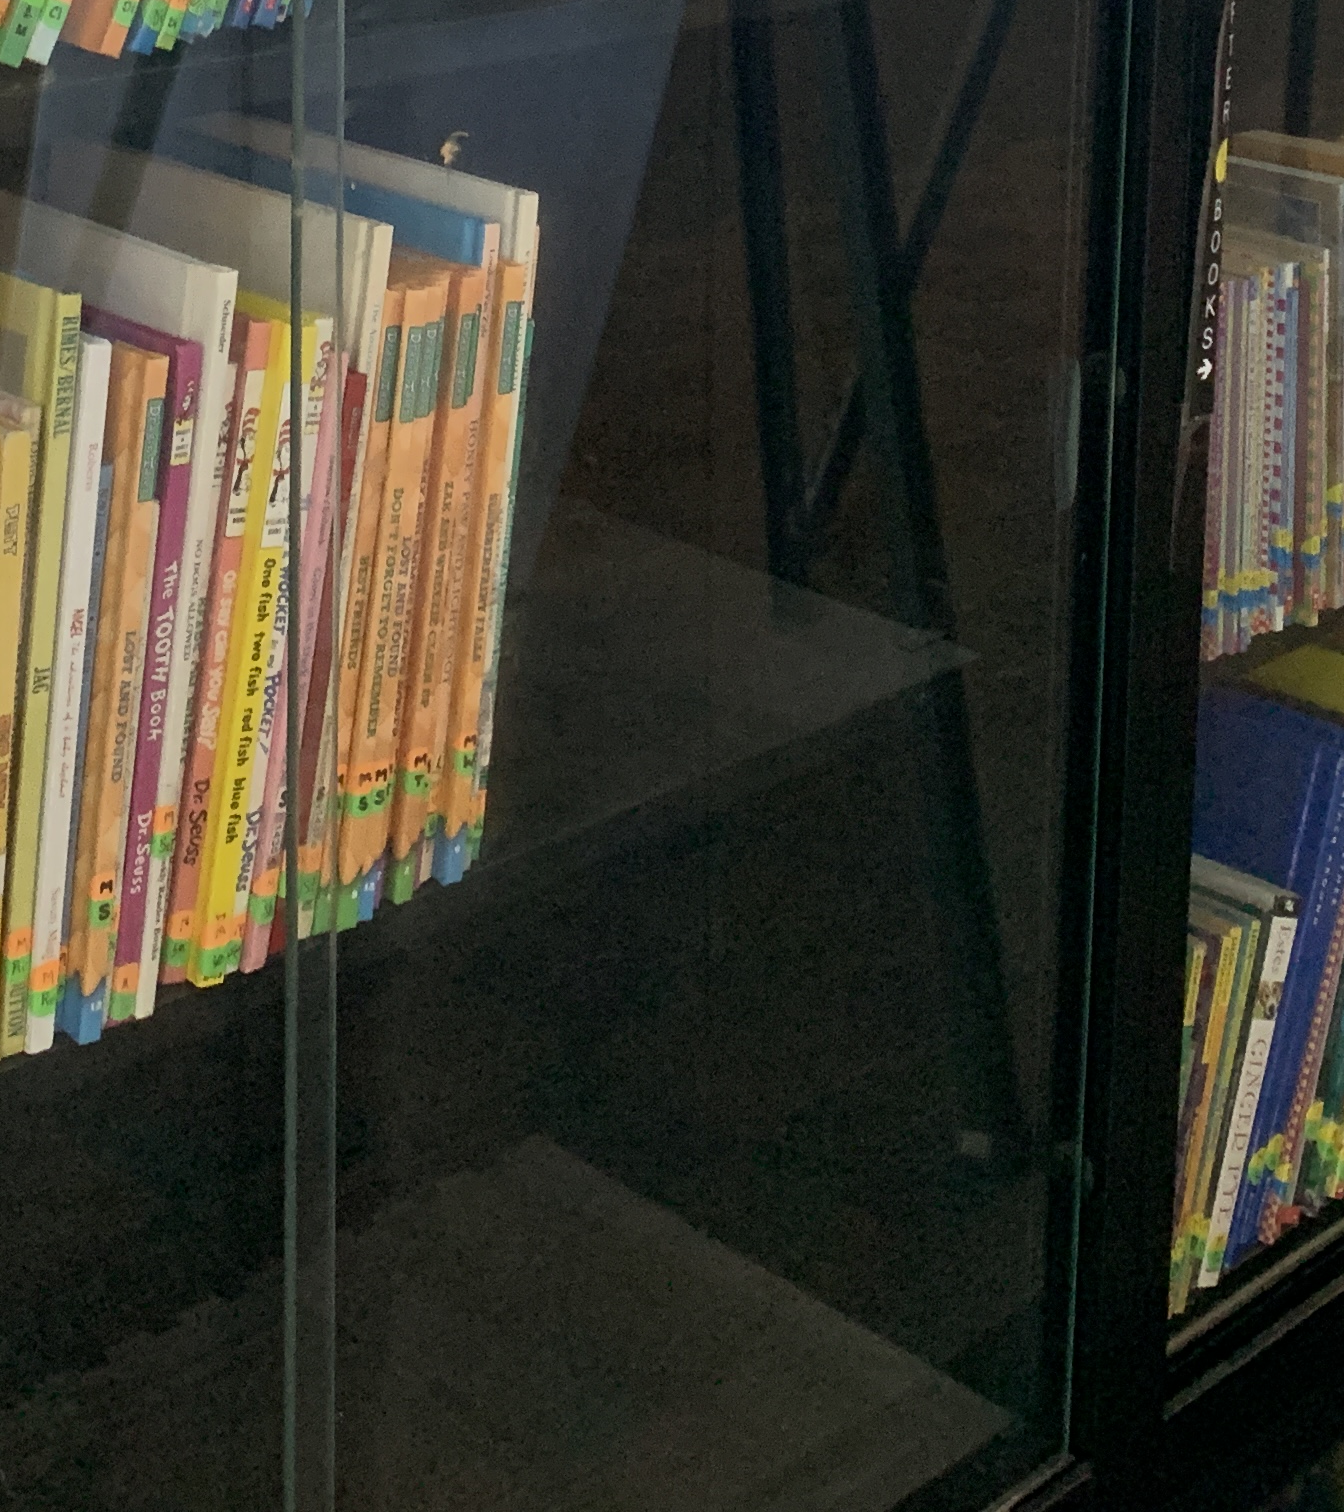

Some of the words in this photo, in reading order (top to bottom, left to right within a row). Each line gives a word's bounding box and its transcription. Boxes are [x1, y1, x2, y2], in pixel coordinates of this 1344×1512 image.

[1200, 197, 1222, 350] BOOKS
[161, 560, 178, 602] The
[260, 557, 277, 588] One
[255, 590, 272, 623] fish
[122, 630, 137, 675] LOST
[150, 610, 174, 684] TOOTH
[246, 660, 262, 698] fish
[111, 723, 129, 784] FOUND
[235, 735, 254, 768] fish
[183, 811, 208, 867] Seuss
[130, 843, 150, 896] Seuss
